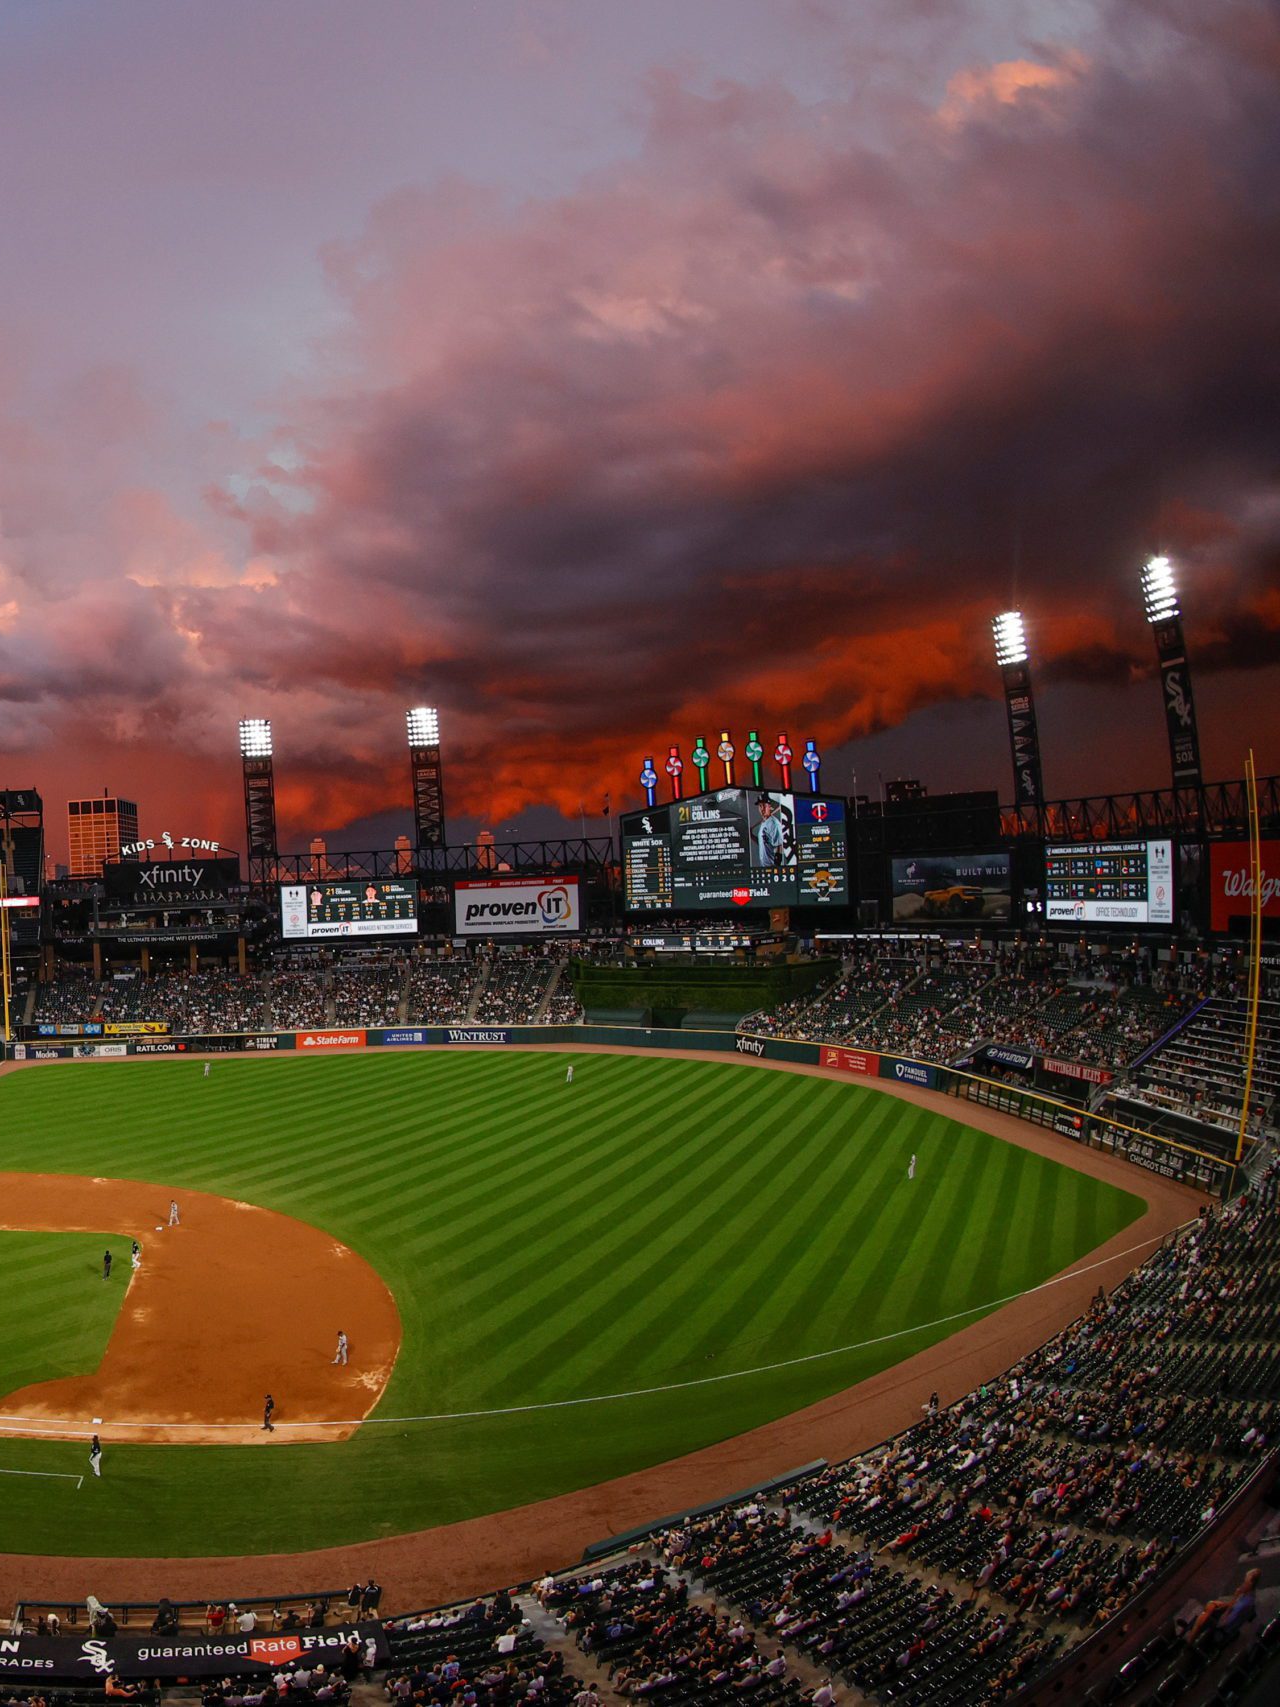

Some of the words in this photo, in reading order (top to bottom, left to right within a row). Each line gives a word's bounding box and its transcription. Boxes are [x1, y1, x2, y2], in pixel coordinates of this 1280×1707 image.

[1175, 750, 1194, 764] SOX
[678, 806, 689, 821] 21
[692, 809, 720, 821] COLLINS
[121, 839, 155, 856] KIDS
[181, 837, 220, 852] ZONE
[139, 865, 204, 889] xfinity
[956, 868, 983, 876] BUILT
[985, 867, 1007, 875] WILD
[699, 890, 733, 900] guaranteed
[733, 889, 748, 897] Rate
[465, 901, 538, 921] proven
[546, 897, 563, 914] IT
[1049, 907, 1075, 917] proven
[1096, 906, 1110, 917] OFFICE
[1110, 906, 1138, 918] TECHNOLOGY
[188, 933, 218, 941] EXPERIENCE
[311, 926, 340, 936] proven
[633, 938, 641, 946] 21
[642, 938, 665, 946] COLLINS
[448, 1030, 506, 1041] WINTRUST
[136, 1044, 176, 1053] RATE.COM
[735, 1036, 765, 1057] xfinity
[35, 1050, 59, 1059] Modelo
[997, 1050, 1028, 1065] HYUNDAI
[904, 1065, 928, 1078] FANDUEL
[1081, 1068, 1102, 1083] MEATS
[1055, 1123, 1081, 1138] RATE.COM
[1130, 1153, 1160, 1173] CHICAGO'S
[1160, 1165, 1174, 1178] BEER
[137, 1641, 248, 1661] guaranteed
[253, 1638, 298, 1654] Rate
[302, 1630, 362, 1649] Field
